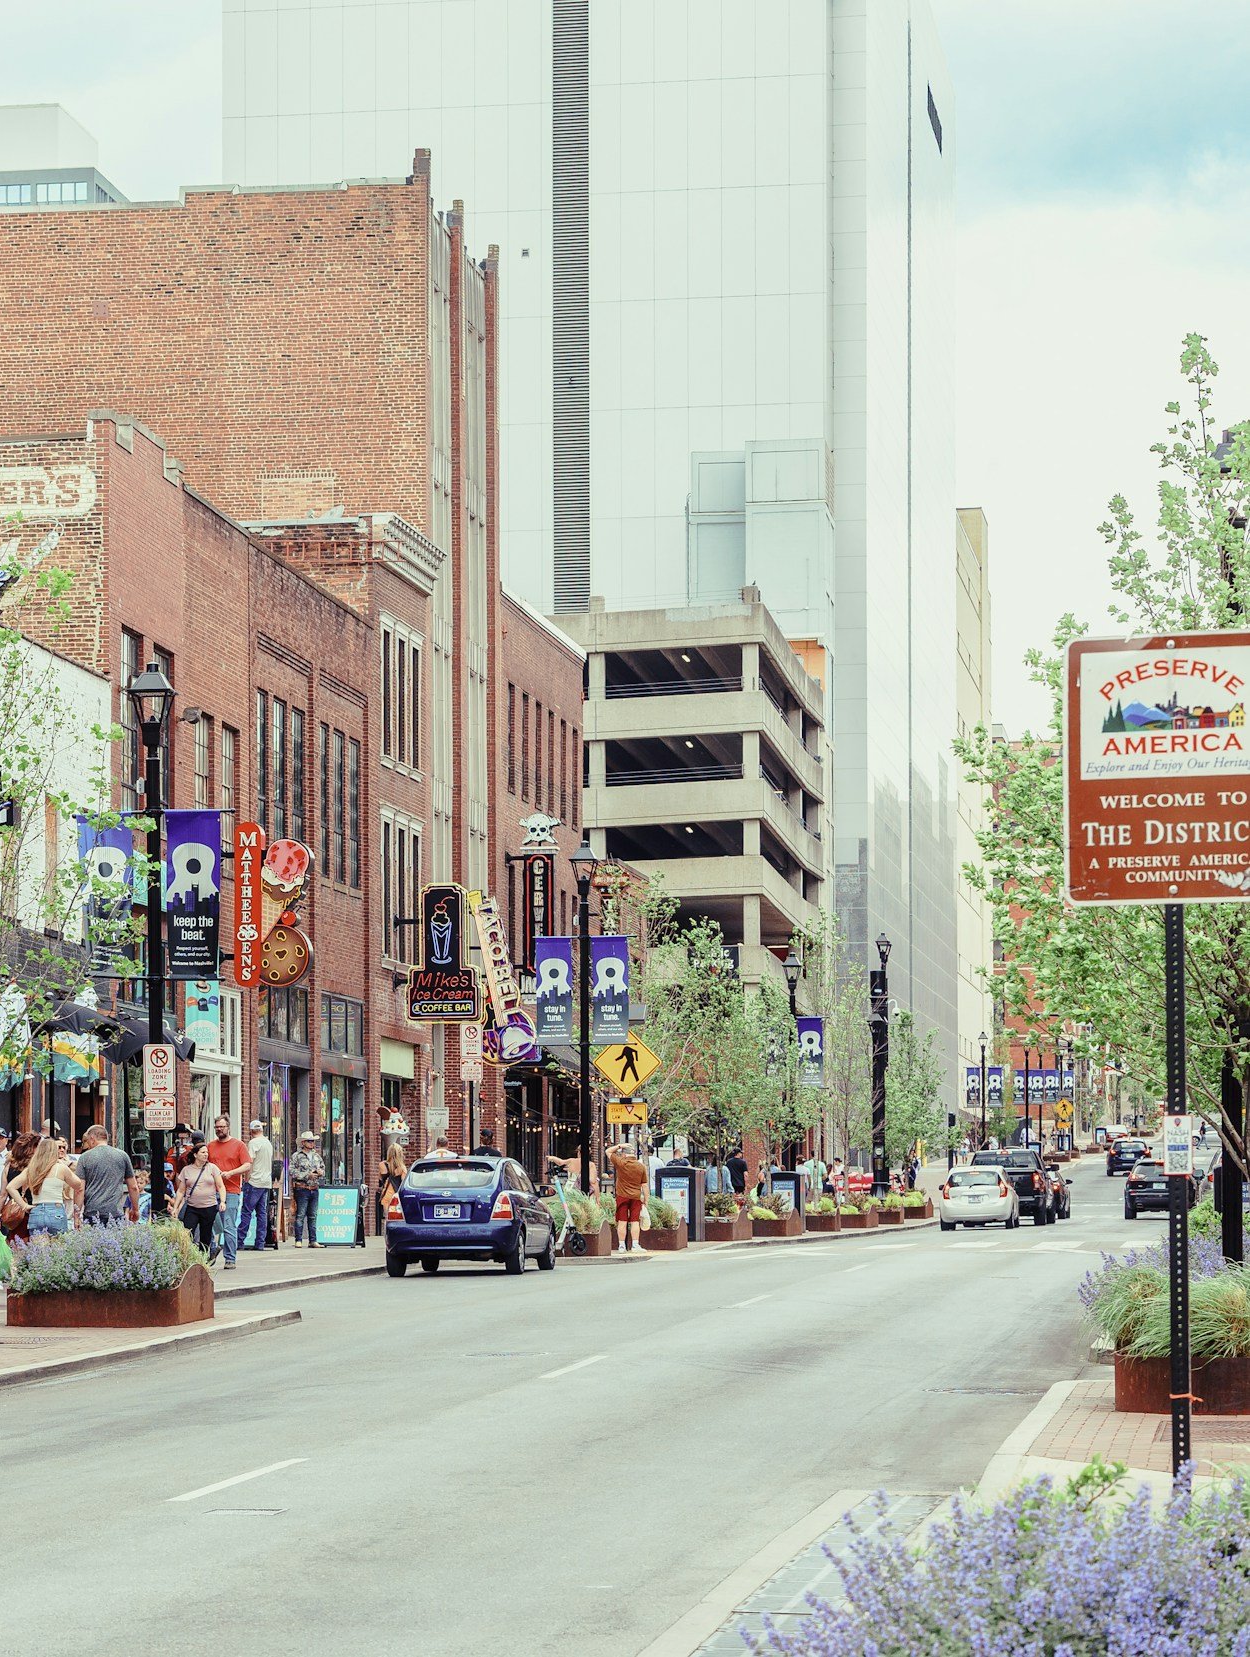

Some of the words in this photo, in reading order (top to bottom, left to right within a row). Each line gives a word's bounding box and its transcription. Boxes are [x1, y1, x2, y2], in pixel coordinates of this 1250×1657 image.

[1099, 659, 1245, 701] PRESERVE
[1102, 733, 1243, 756] AMERICA
[1085, 761, 1125, 777] Explore
[1128, 760, 1149, 772] and
[1153, 758, 1183, 773] Enjoy
[1187, 757, 1210, 769] Our
[1100, 792, 1205, 809] WELCOME
[1217, 791, 1247, 806] TO
[1081, 822, 1132, 846] THE
[1144, 820, 1250, 845] DISTRIC
[1089, 857, 1099, 869] A
[1108, 855, 1180, 869] PRESERVE
[1189, 853, 1250, 866] AMERIC
[1125, 869, 1220, 883] COMMUNITY
[533, 859, 545, 936] CERVE
[173, 915, 197, 930] keep
[198, 914, 214, 928] the
[478, 896, 507, 961] TACO
[181, 929, 206, 941] beat.
[416, 971, 469, 988] Mike's
[412, 988, 431, 1000] Ice
[432, 987, 473, 1001] Cream
[493, 966, 523, 1027] BELL
[421, 1003, 453, 1012] COFFEE
[454, 1003, 472, 1011] BAR
[544, 1005, 559, 1014] stay
[559, 1004, 566, 1012] in
[600, 1005, 615, 1014] stay
[616, 1004, 622, 1012] in
[603, 1013, 620, 1021] tune.
[332, 1216, 340, 1224] &
